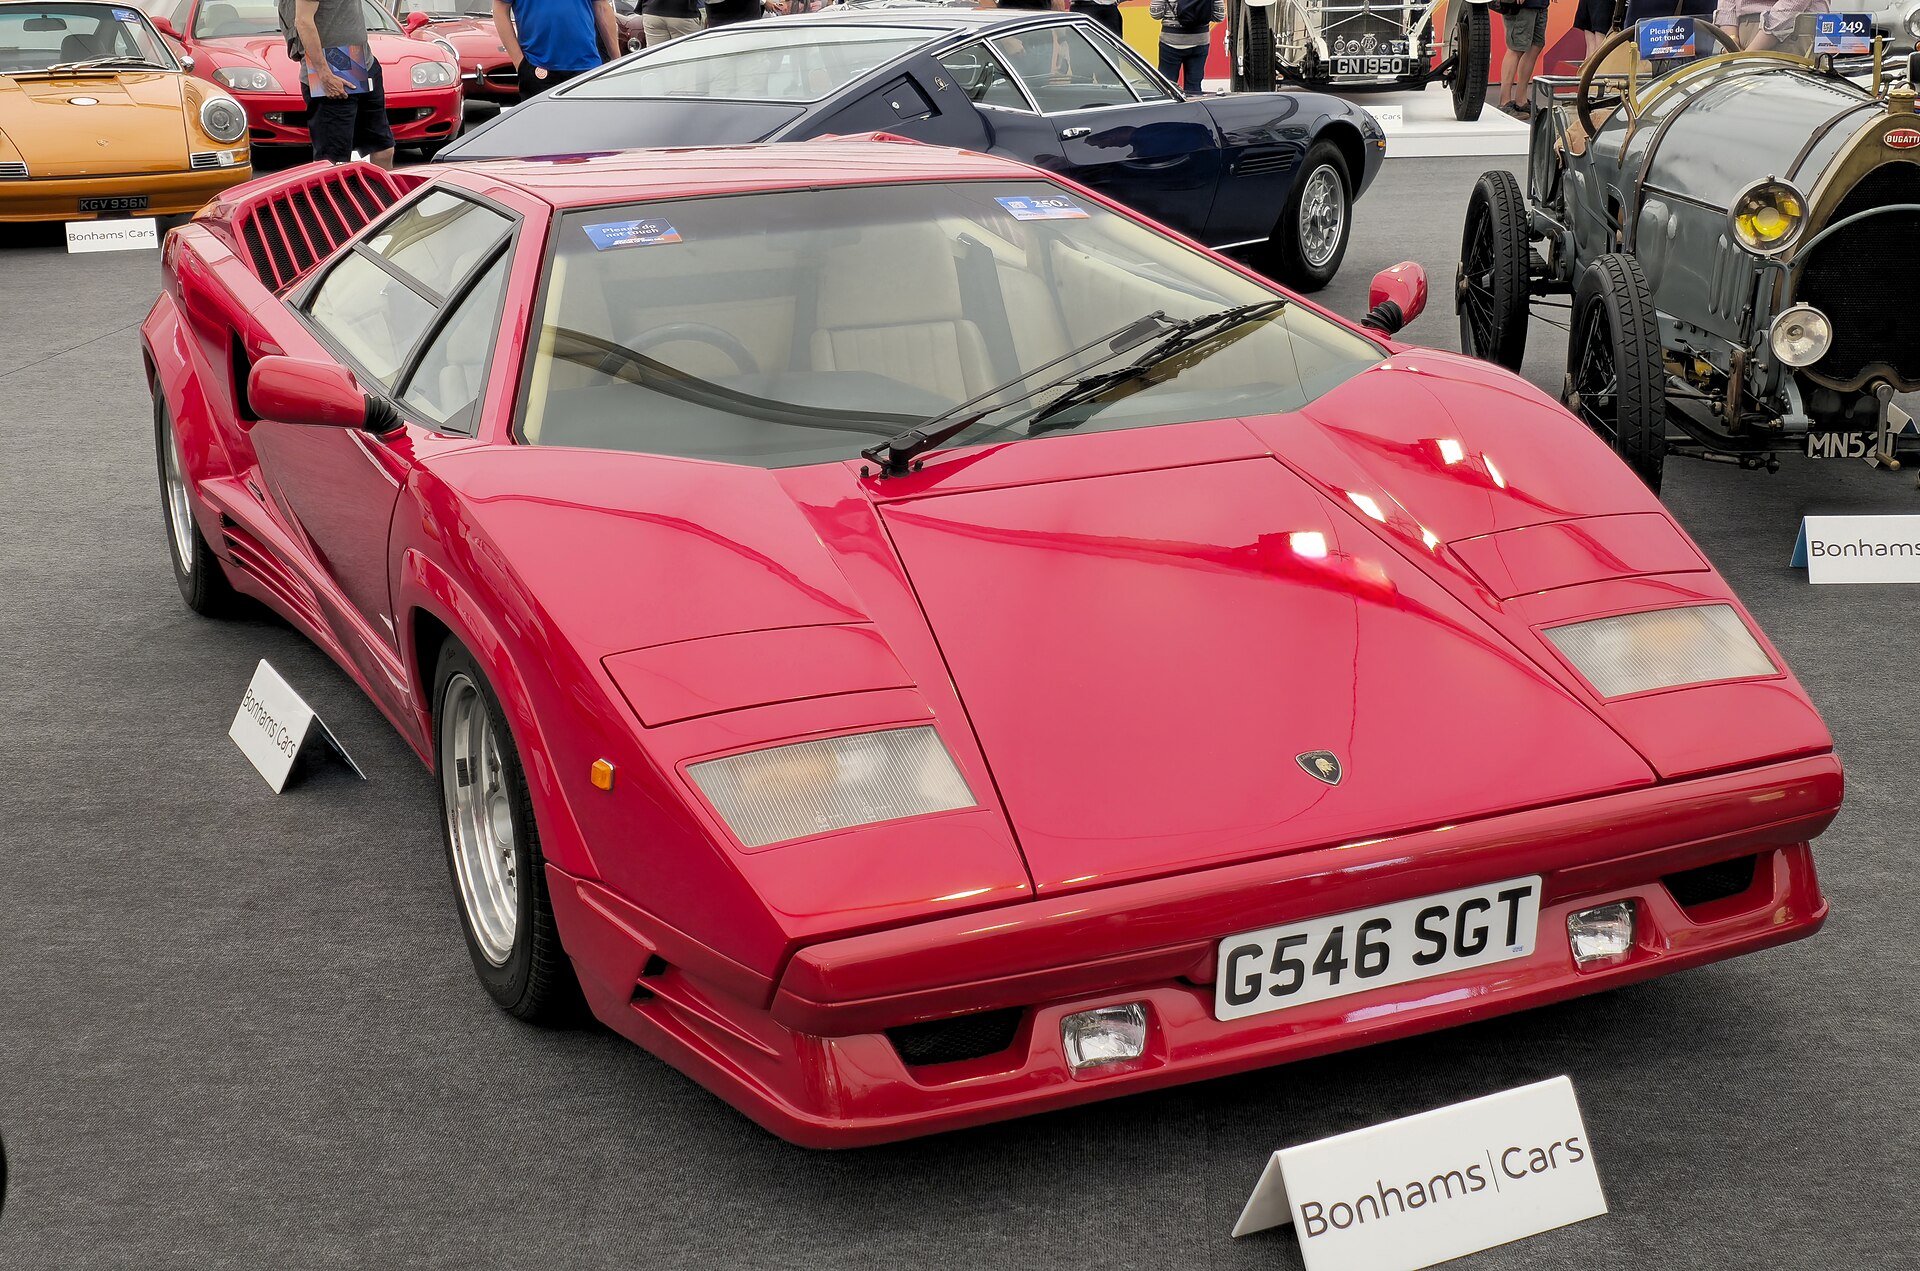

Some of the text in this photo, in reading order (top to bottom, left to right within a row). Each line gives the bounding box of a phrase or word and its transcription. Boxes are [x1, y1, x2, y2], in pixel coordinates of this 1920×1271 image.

[1838, 21, 1865, 34] 249.
[1337, 58, 1403, 74] GN 1950
[1886, 135, 1920, 143] BUGATTI
[80, 198, 147, 210] KGV 936N
[602, 225, 639, 233] Please
[68, 230, 155, 242] Bonhams Cars
[243, 688, 296, 759] Bonhams Cars
[1224, 885, 1533, 1007] G546 SGT
[1299, 1136, 1585, 1239] Bonhams Cars
